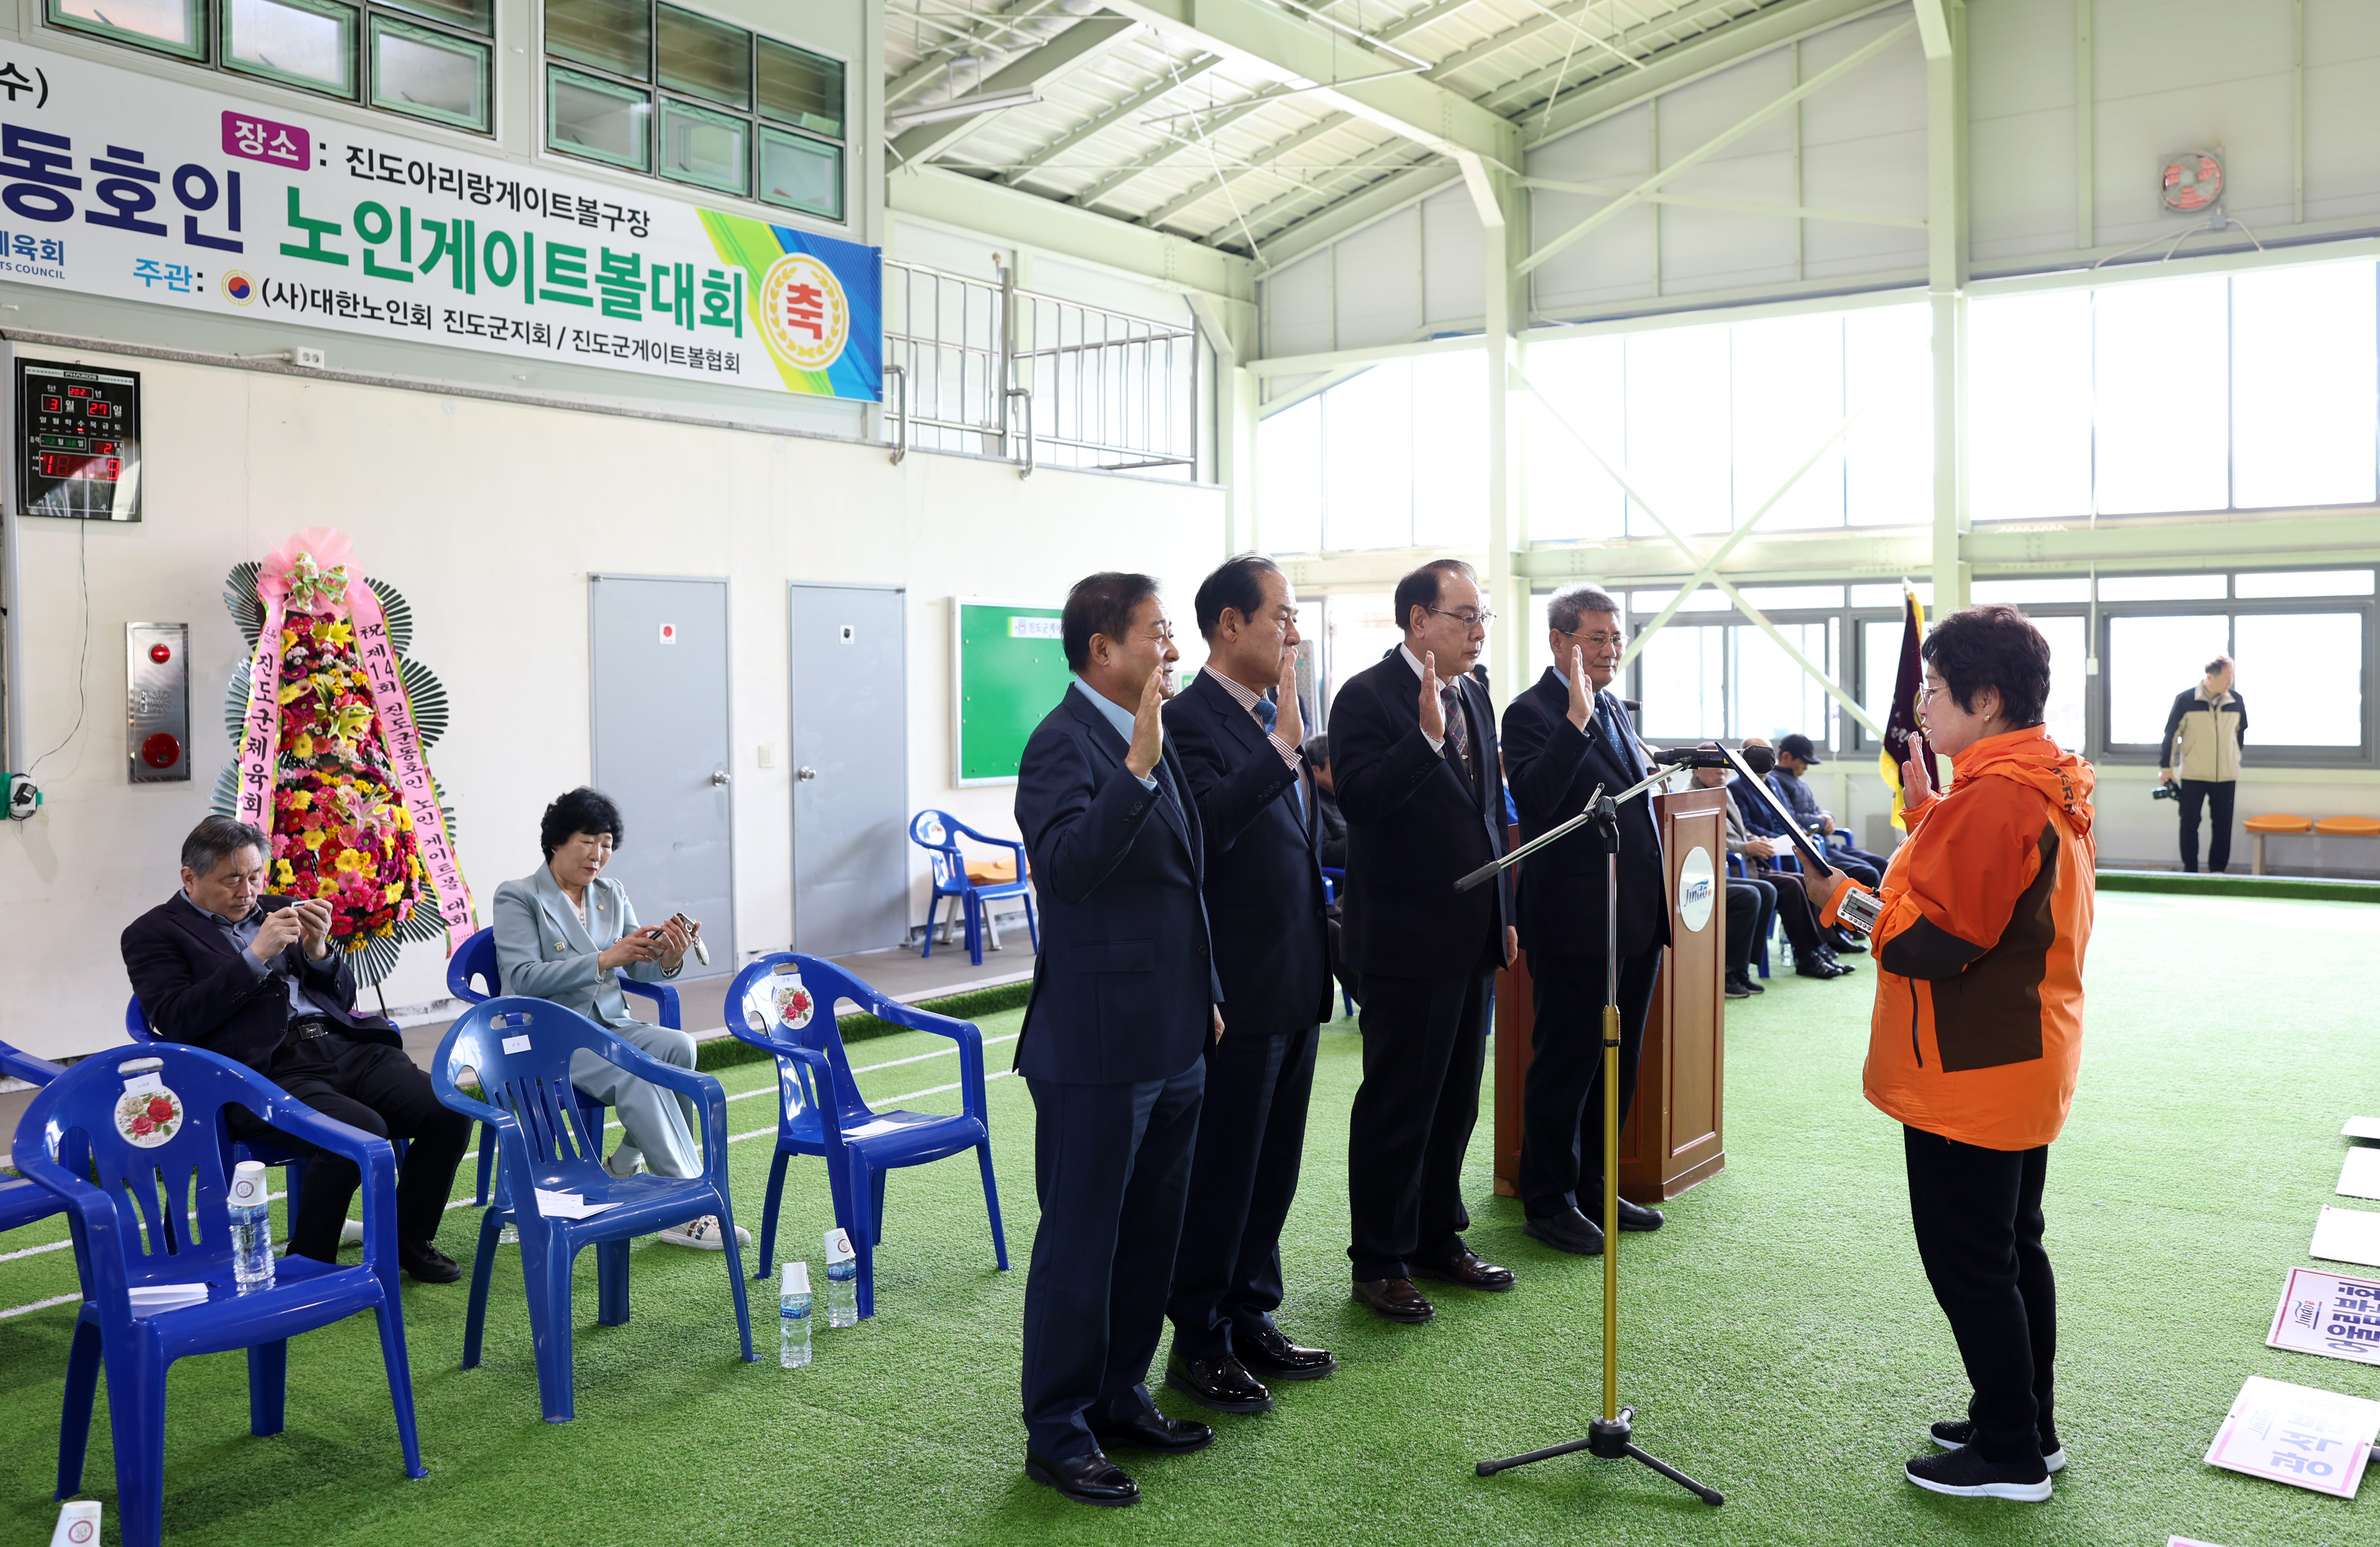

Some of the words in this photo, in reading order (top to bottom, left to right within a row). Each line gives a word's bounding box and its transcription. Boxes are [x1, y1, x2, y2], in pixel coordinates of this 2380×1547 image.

[234, 119, 299, 162] 장소
[345, 144, 650, 238] 진도아리랑게이트볼구장
[0, 122, 244, 254] 동호인
[280, 185, 742, 339] 노인게이트볼대회
[16, 263, 66, 280] COUNCIL
[261, 277, 432, 331] (사)대한노인회
[443, 309, 551, 348] 진도군지회
[572, 328, 740, 375] 진도군게이트볼협회
[786, 283, 824, 341] 축
[50, 399, 58, 410] 3
[89, 403, 108, 415] 27
[359, 623, 385, 640] 祝
[242, 652, 275, 829] 진도군체육회
[1683, 885, 1708, 907] Jindo
[445, 897, 468, 926] 대회
[2295, 1305, 2315, 1328] Jindo
